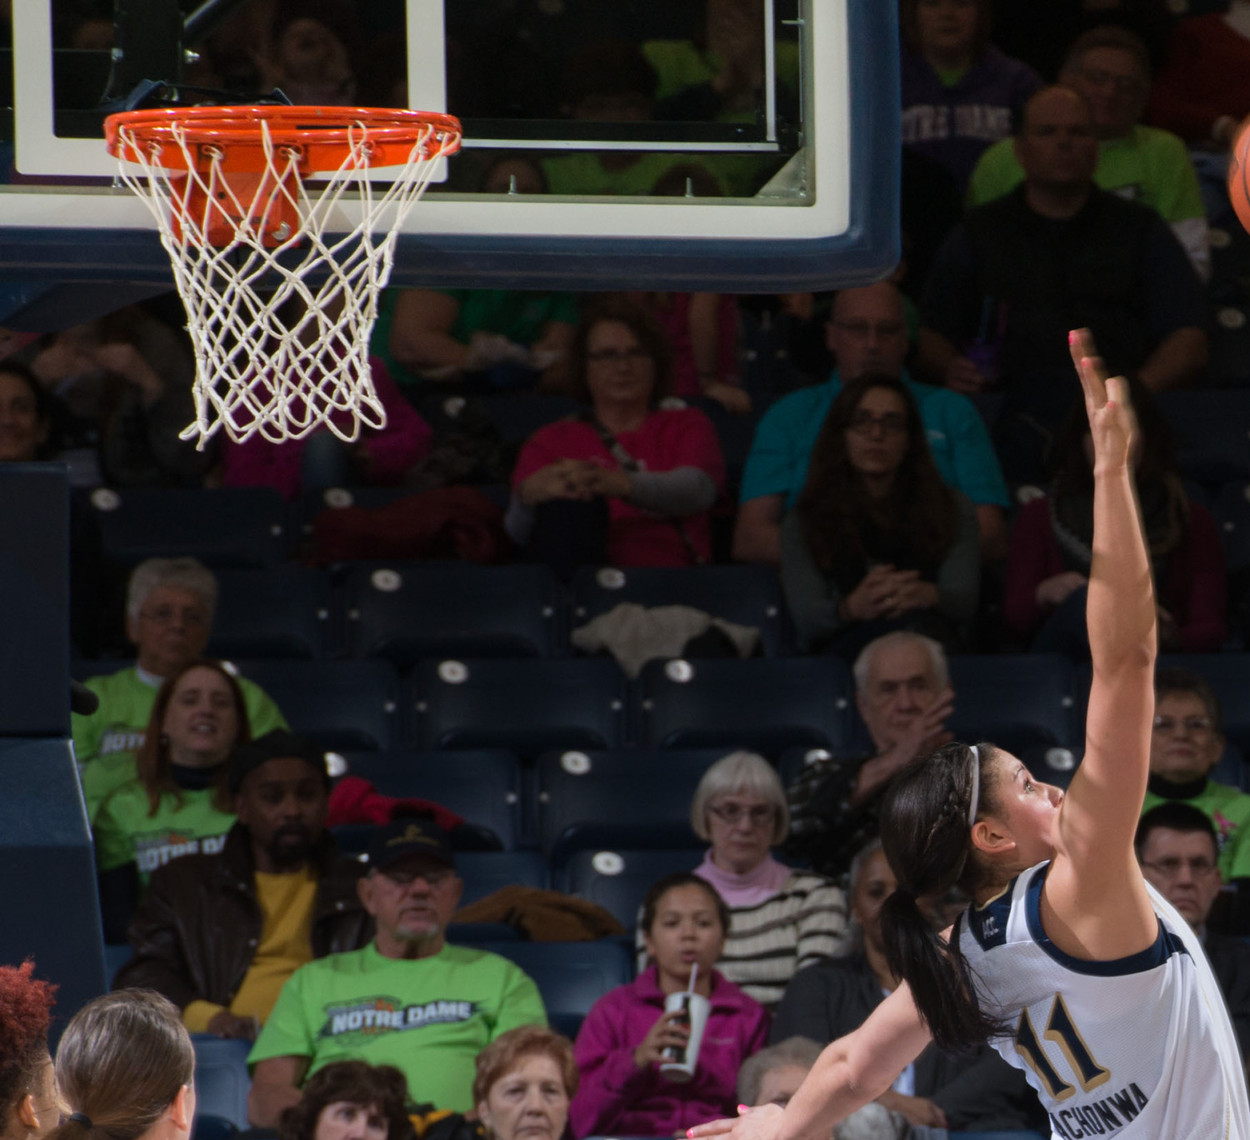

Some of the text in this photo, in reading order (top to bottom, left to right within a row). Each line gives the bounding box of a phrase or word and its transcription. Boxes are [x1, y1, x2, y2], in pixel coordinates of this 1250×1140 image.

[332, 1000, 472, 1036] NOTRE DAME
[1012, 990, 1112, 1101] 11
